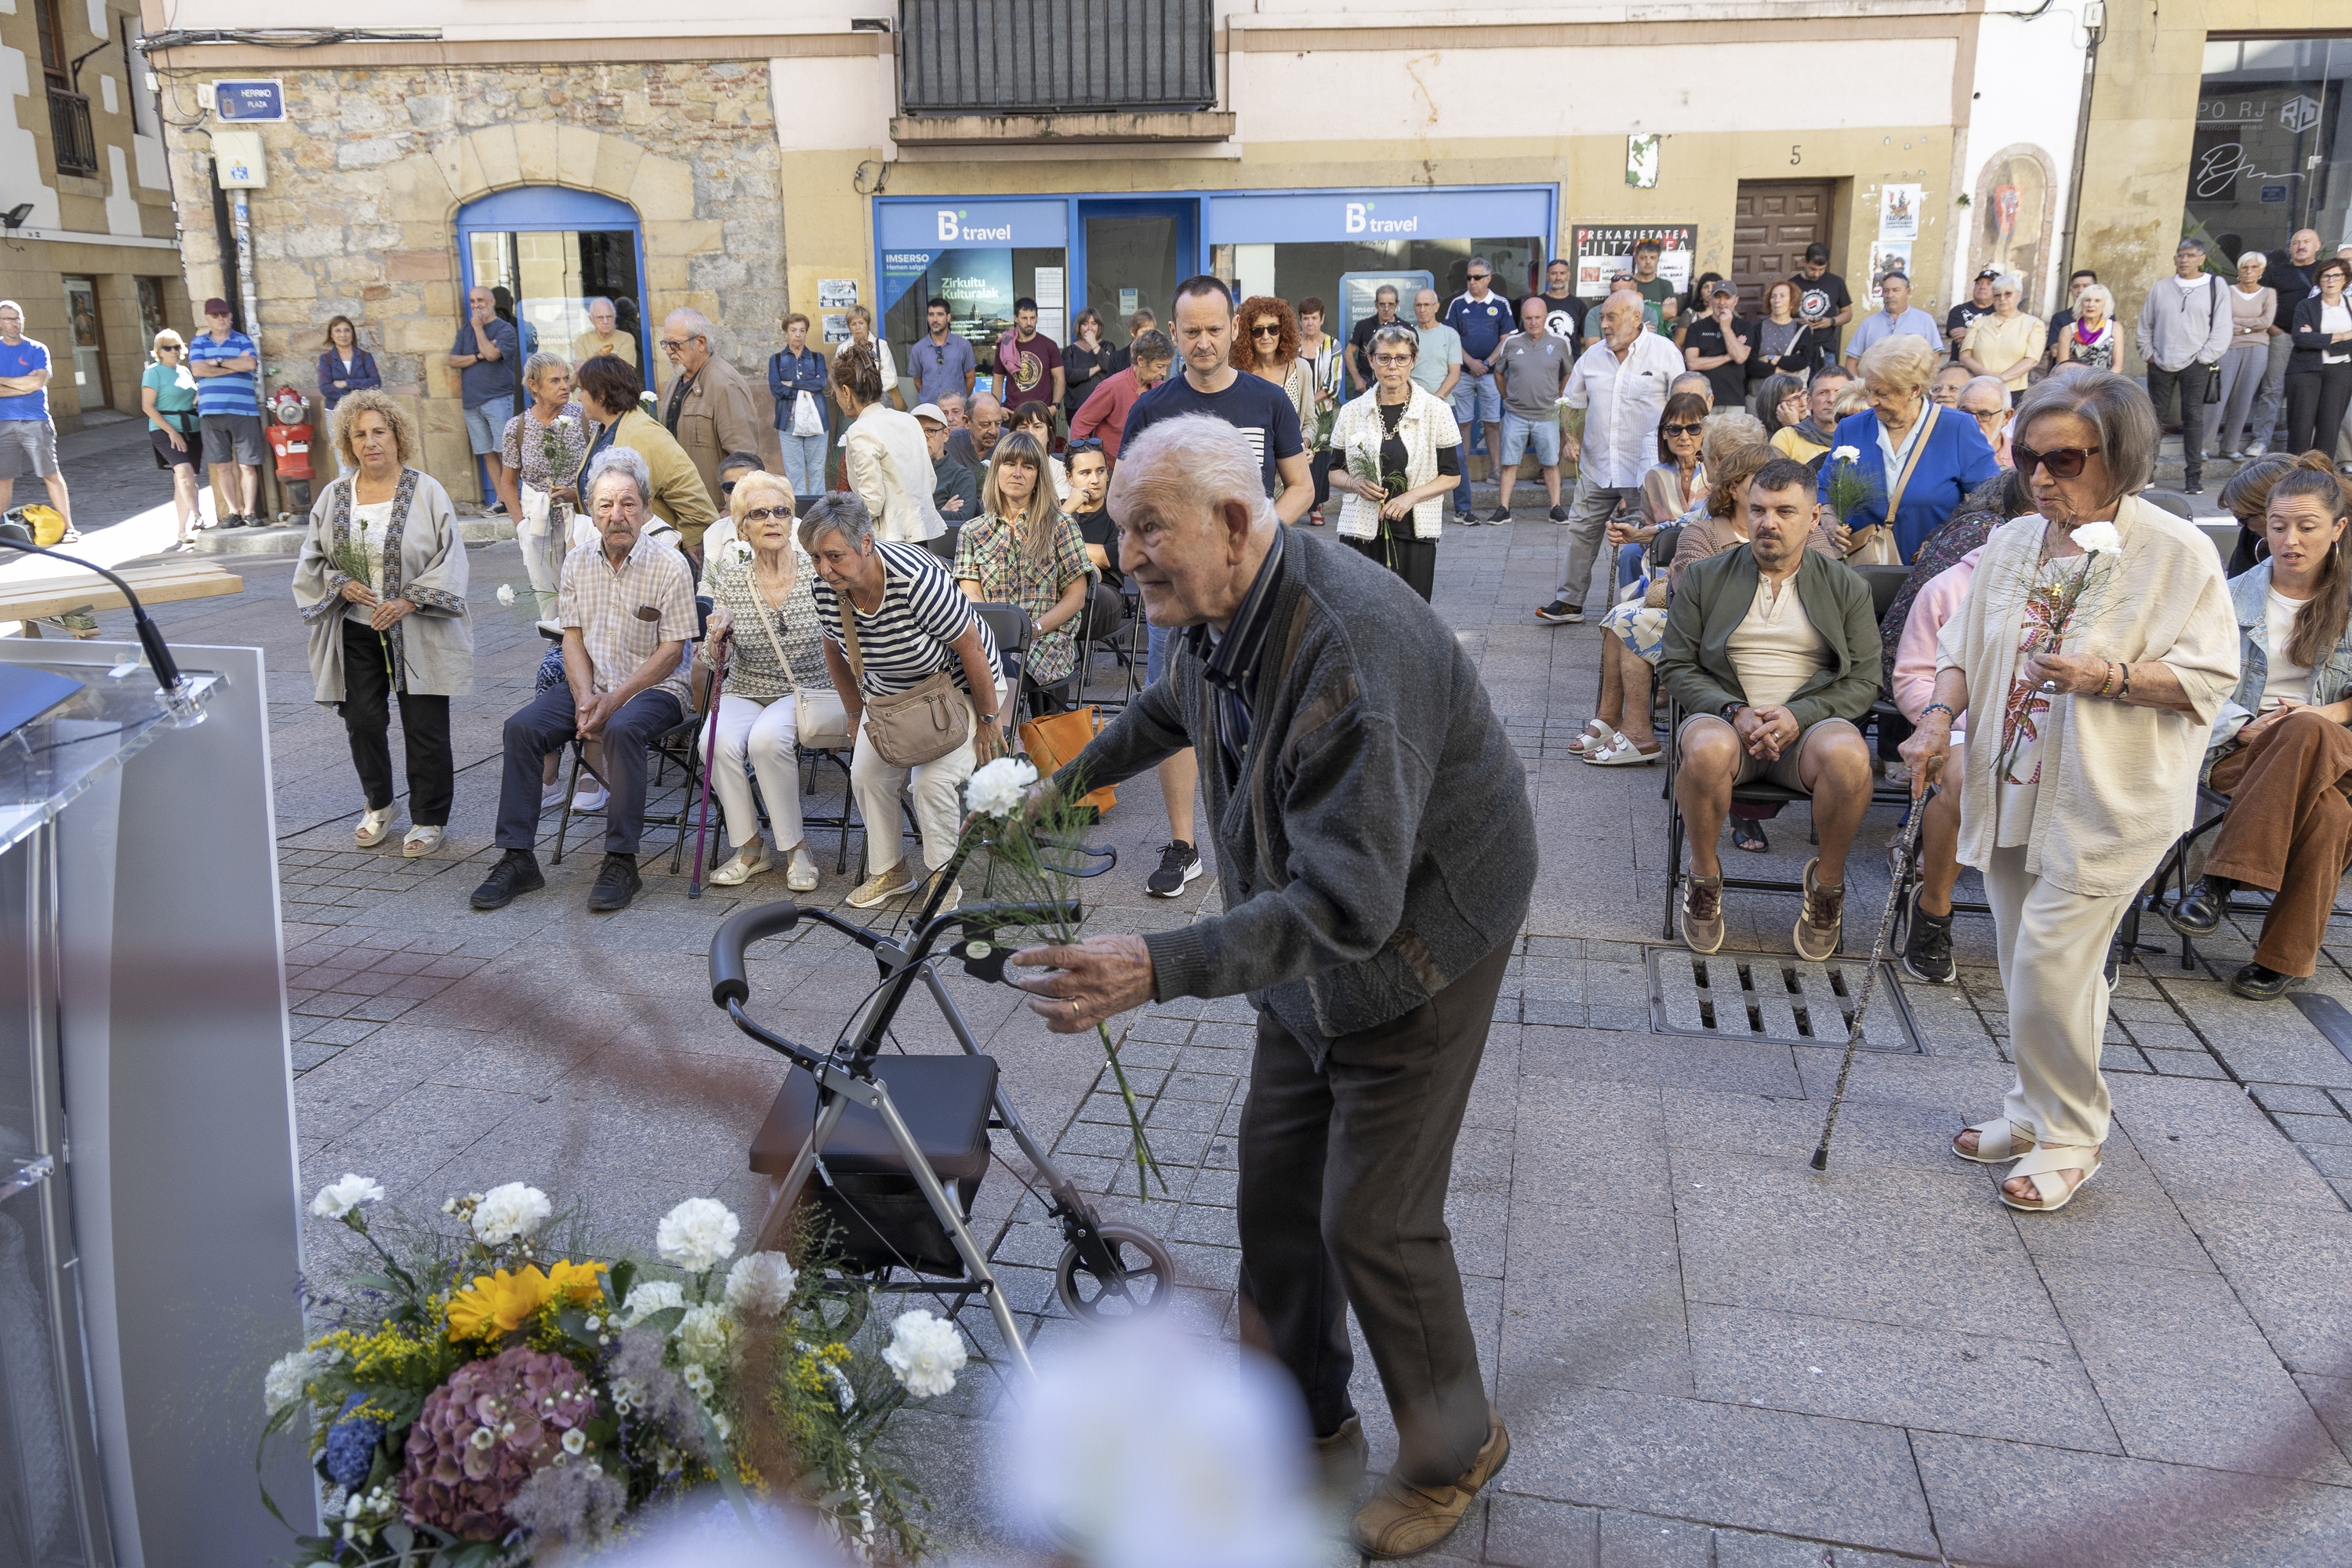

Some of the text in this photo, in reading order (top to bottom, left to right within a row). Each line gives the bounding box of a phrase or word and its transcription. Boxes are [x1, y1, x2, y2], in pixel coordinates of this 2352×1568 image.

[241, 89, 272, 98] HERRIKO
[2239, 100, 2266, 118] RJ
[1790, 144, 1802, 165] 5
[1346, 202, 1417, 233] B travel
[938, 210, 1011, 241] B travel
[1577, 229, 1689, 241] PREKARIETATEA
[886, 253, 930, 263] IMSERSO
[942, 277, 985, 289] Zirkuitu
[942, 287, 1000, 299] Kulturalak
[532, 336, 571, 345] Vietnam
